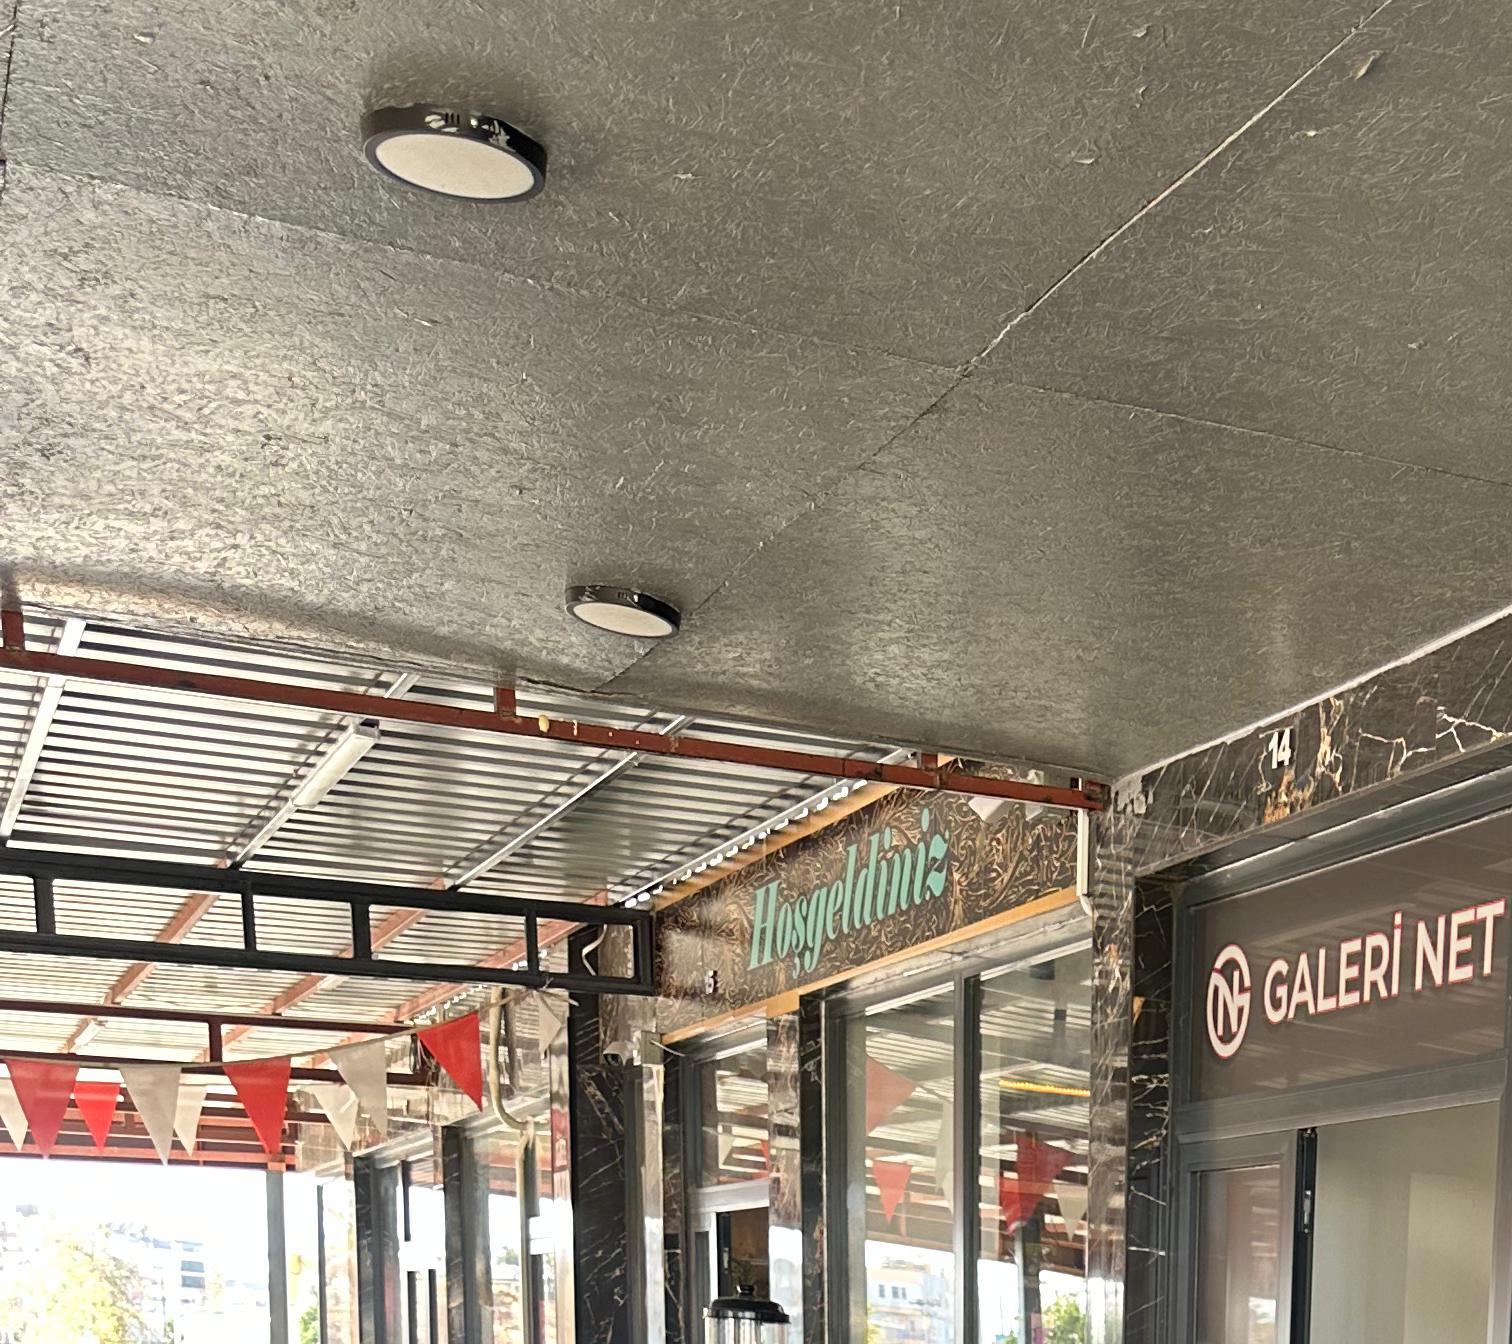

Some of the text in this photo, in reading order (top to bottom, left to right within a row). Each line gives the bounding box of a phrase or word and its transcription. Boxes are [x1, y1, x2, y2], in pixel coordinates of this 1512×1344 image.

[1268, 727, 1292, 770] 14
[746, 807, 950, 980] Hoşgeldiniz
[1263, 896, 1507, 1025] GALERİ NET
